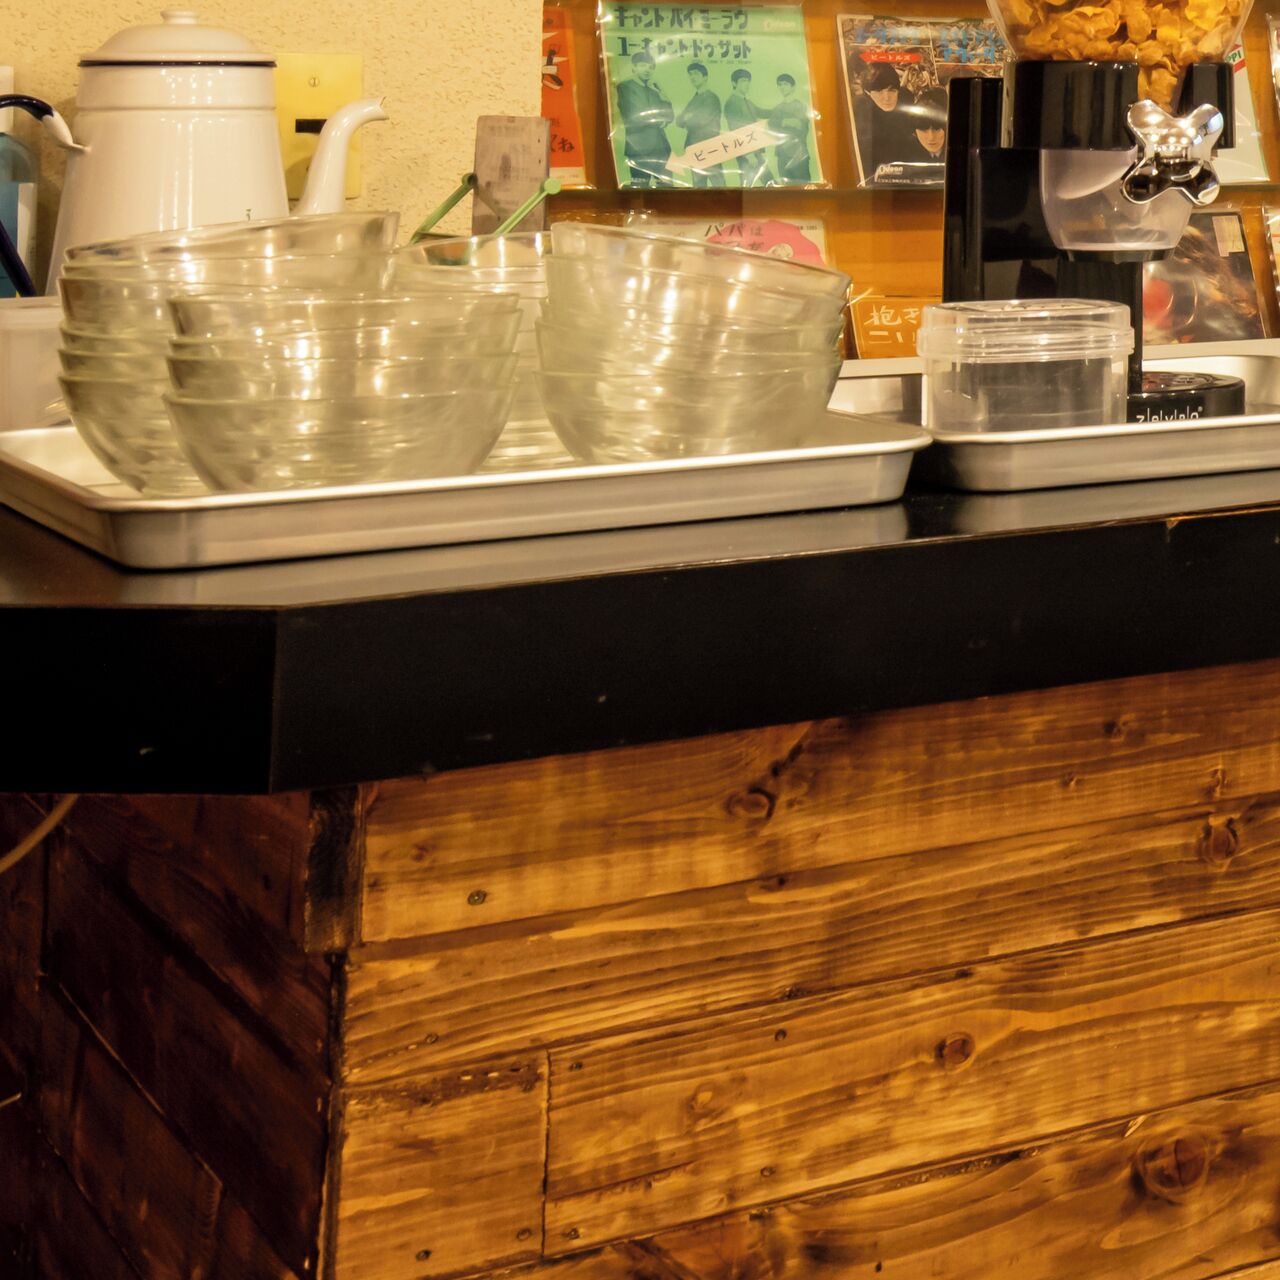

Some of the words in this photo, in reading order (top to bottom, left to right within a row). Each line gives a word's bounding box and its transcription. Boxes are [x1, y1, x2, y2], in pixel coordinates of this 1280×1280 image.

[694, 131, 758, 162] ビートルズ
[704, 222, 764, 238] パパは
